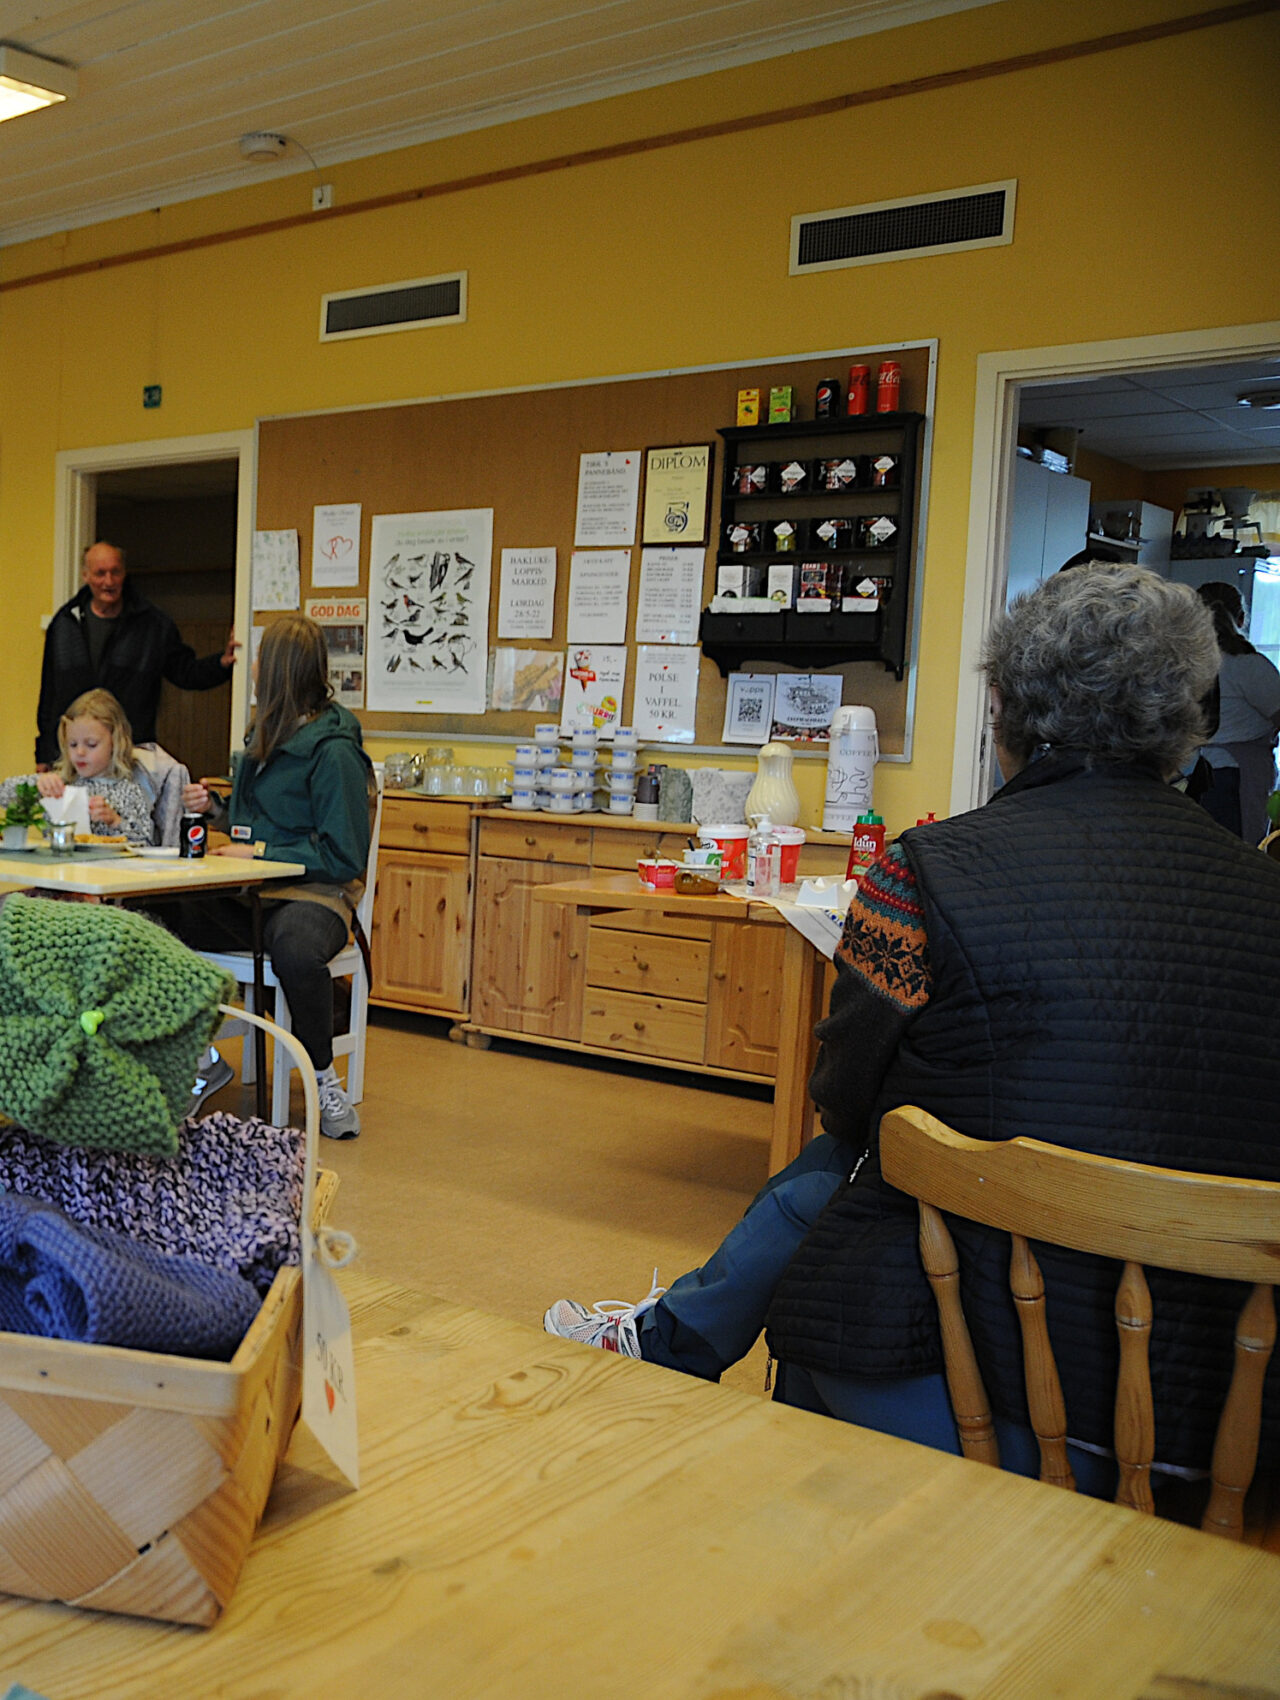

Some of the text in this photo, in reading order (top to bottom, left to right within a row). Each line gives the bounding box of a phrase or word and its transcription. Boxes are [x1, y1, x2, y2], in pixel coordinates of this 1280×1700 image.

[651, 455, 707, 471] DIPLOM
[311, 604, 360, 617] GOD DAG
[854, 836, 876, 849] Idun
